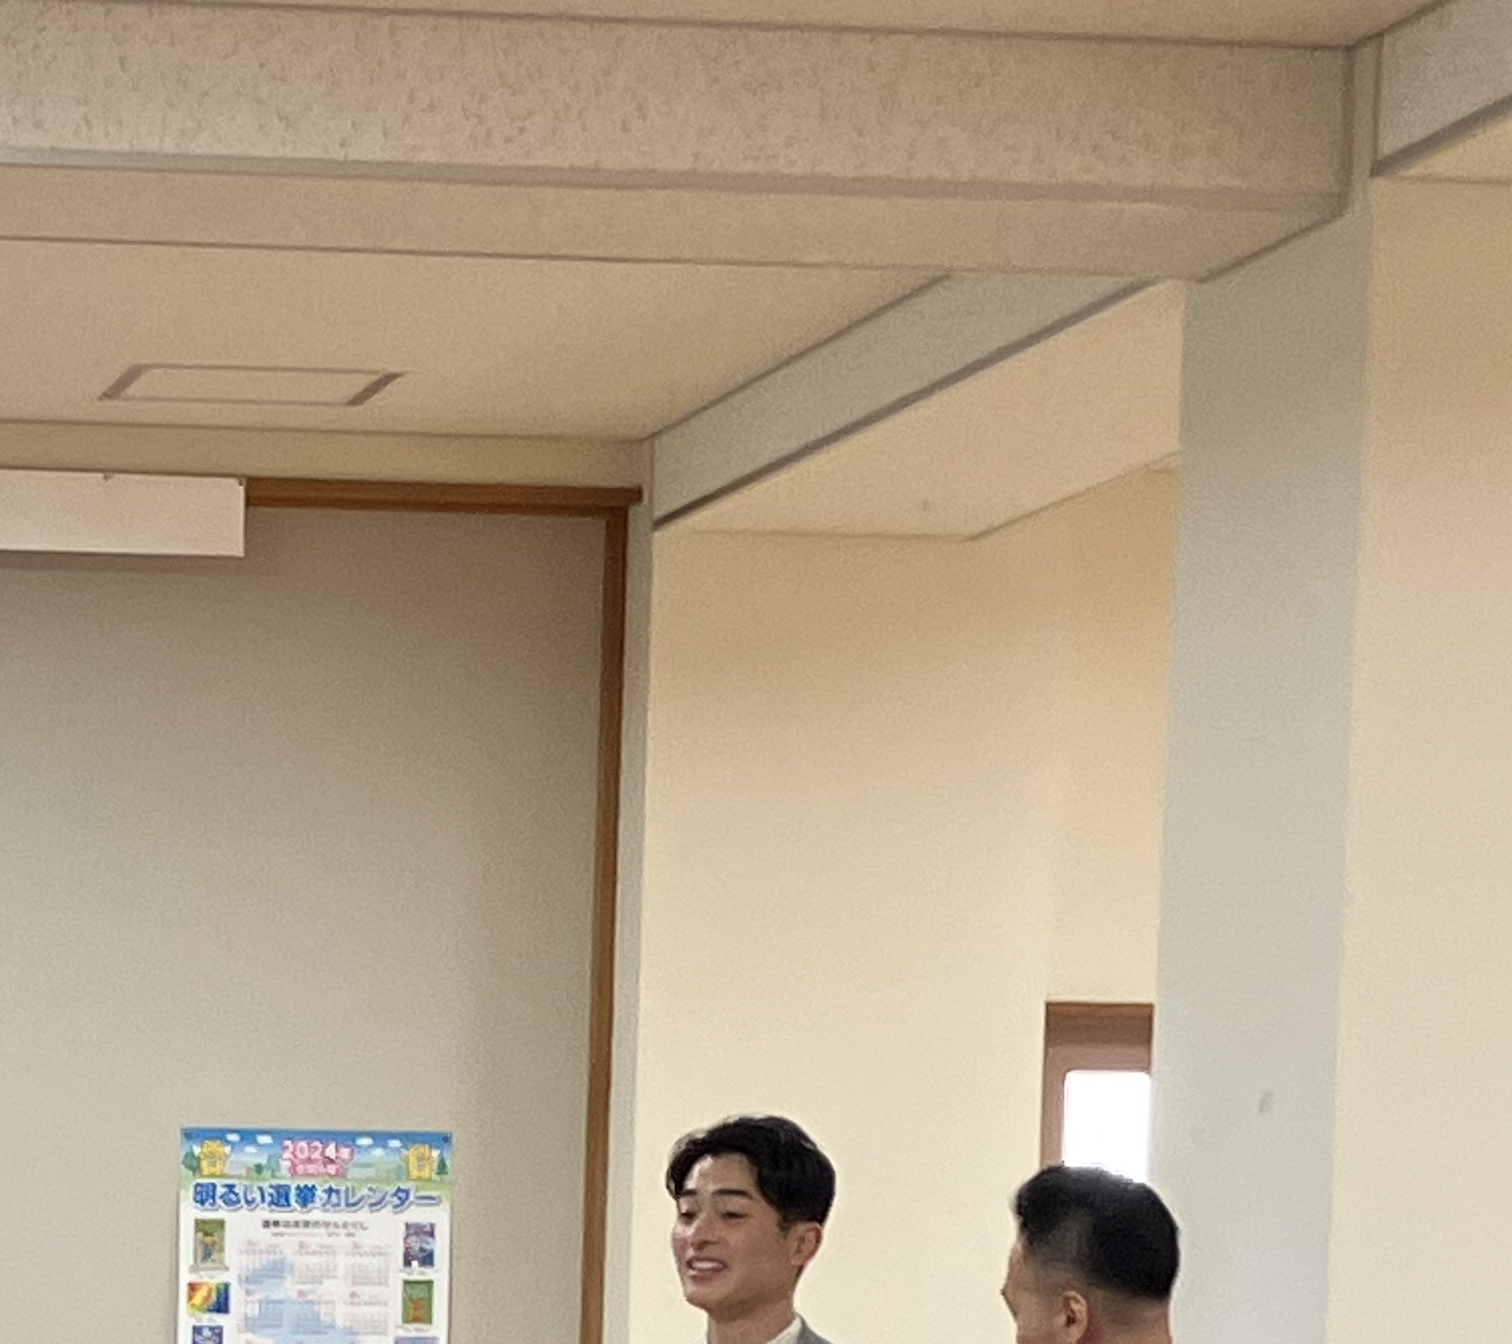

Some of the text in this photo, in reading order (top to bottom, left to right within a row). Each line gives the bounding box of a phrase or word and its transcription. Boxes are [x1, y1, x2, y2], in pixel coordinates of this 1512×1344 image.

[193, 1181, 437, 1211] 明るい選挙カレンダー
